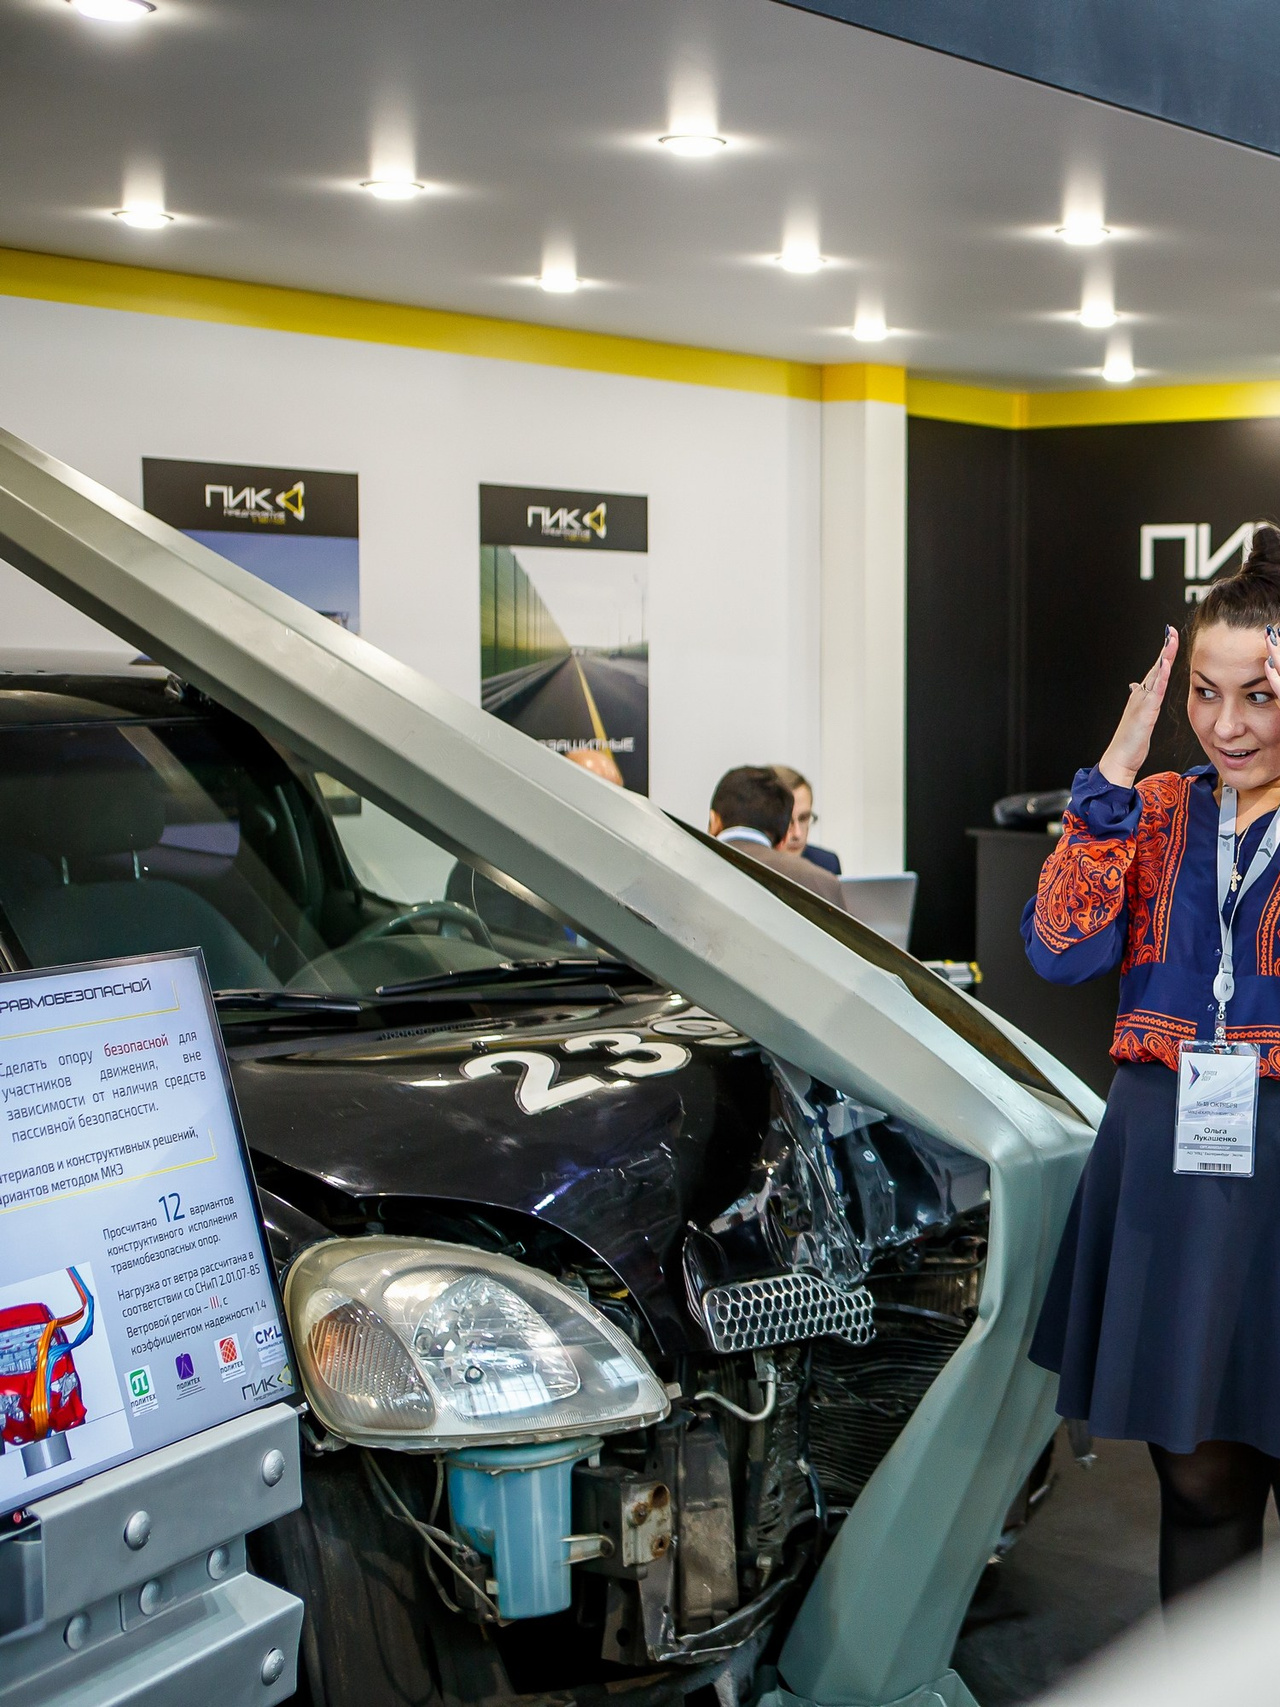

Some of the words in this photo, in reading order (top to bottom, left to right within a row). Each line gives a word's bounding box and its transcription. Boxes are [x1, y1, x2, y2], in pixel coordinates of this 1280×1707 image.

[205, 484, 273, 512] ПИК
[527, 505, 581, 529] ПИК
[58, 1050, 93, 1066] опору
[104, 1033, 169, 1057] безопасной
[178, 1031, 197, 1046] для
[1, 1076, 72, 1102] участников
[100, 1060, 158, 1081] движения,
[183, 1051, 202, 1064] вне
[6, 1095, 86, 1121] зависимости
[92, 1091, 105, 1103] от
[112, 1080, 158, 1099] наличия
[164, 1070, 206, 1088] средств
[11, 1116, 76, 1143] пассивной
[78, 1102, 159, 1128] безопасности.
[1193, 1134, 1237, 1143] Лукашенко
[1204, 1127, 1227, 1135] Ольга
[57, 1160, 64, 1171] и
[66, 1139, 151, 1167] конструктивных
[152, 1126, 199, 1150] решений,
[51, 1172, 100, 1192] методом
[101, 1163, 124, 1180] МКЭ
[102, 1217, 158, 1241] Просчитано
[158, 1192, 185, 1223] 12
[189, 1195, 234, 1216] вариантов
[107, 1227, 184, 1257] конструктивного
[188, 1211, 238, 1233] исполнения
[111, 1241, 196, 1275] травмобезопасных
[198, 1233, 221, 1249] опор.
[117, 1280, 160, 1301] Нагрузка
[162, 1276, 172, 1287] от
[173, 1268, 199, 1283] ветра
[200, 1253, 247, 1277] рассчитана
[248, 1251, 254, 1260] в
[122, 1292, 183, 1318] соответствии
[184, 1288, 195, 1298] со
[195, 1277, 218, 1294] СНиП
[220, 1263, 261, 1287] 2.01.07-85
[126, 1316, 170, 1339] Ветровой
[171, 1305, 202, 1323] регион
[223, 1297, 228, 1306] с
[130, 1321, 203, 1355] коэффициентом
[204, 1304, 255, 1330] надежности
[255, 1299, 267, 1312] 1.4
[255, 1325, 282, 1344] CML
[176, 1377, 201, 1390] ПОЛИТЕХ
[220, 1360, 244, 1374] ПОЛИТЕХ
[130, 1393, 156, 1408] ПОЛИТЕХ
[242, 1374, 277, 1400] ПИК
